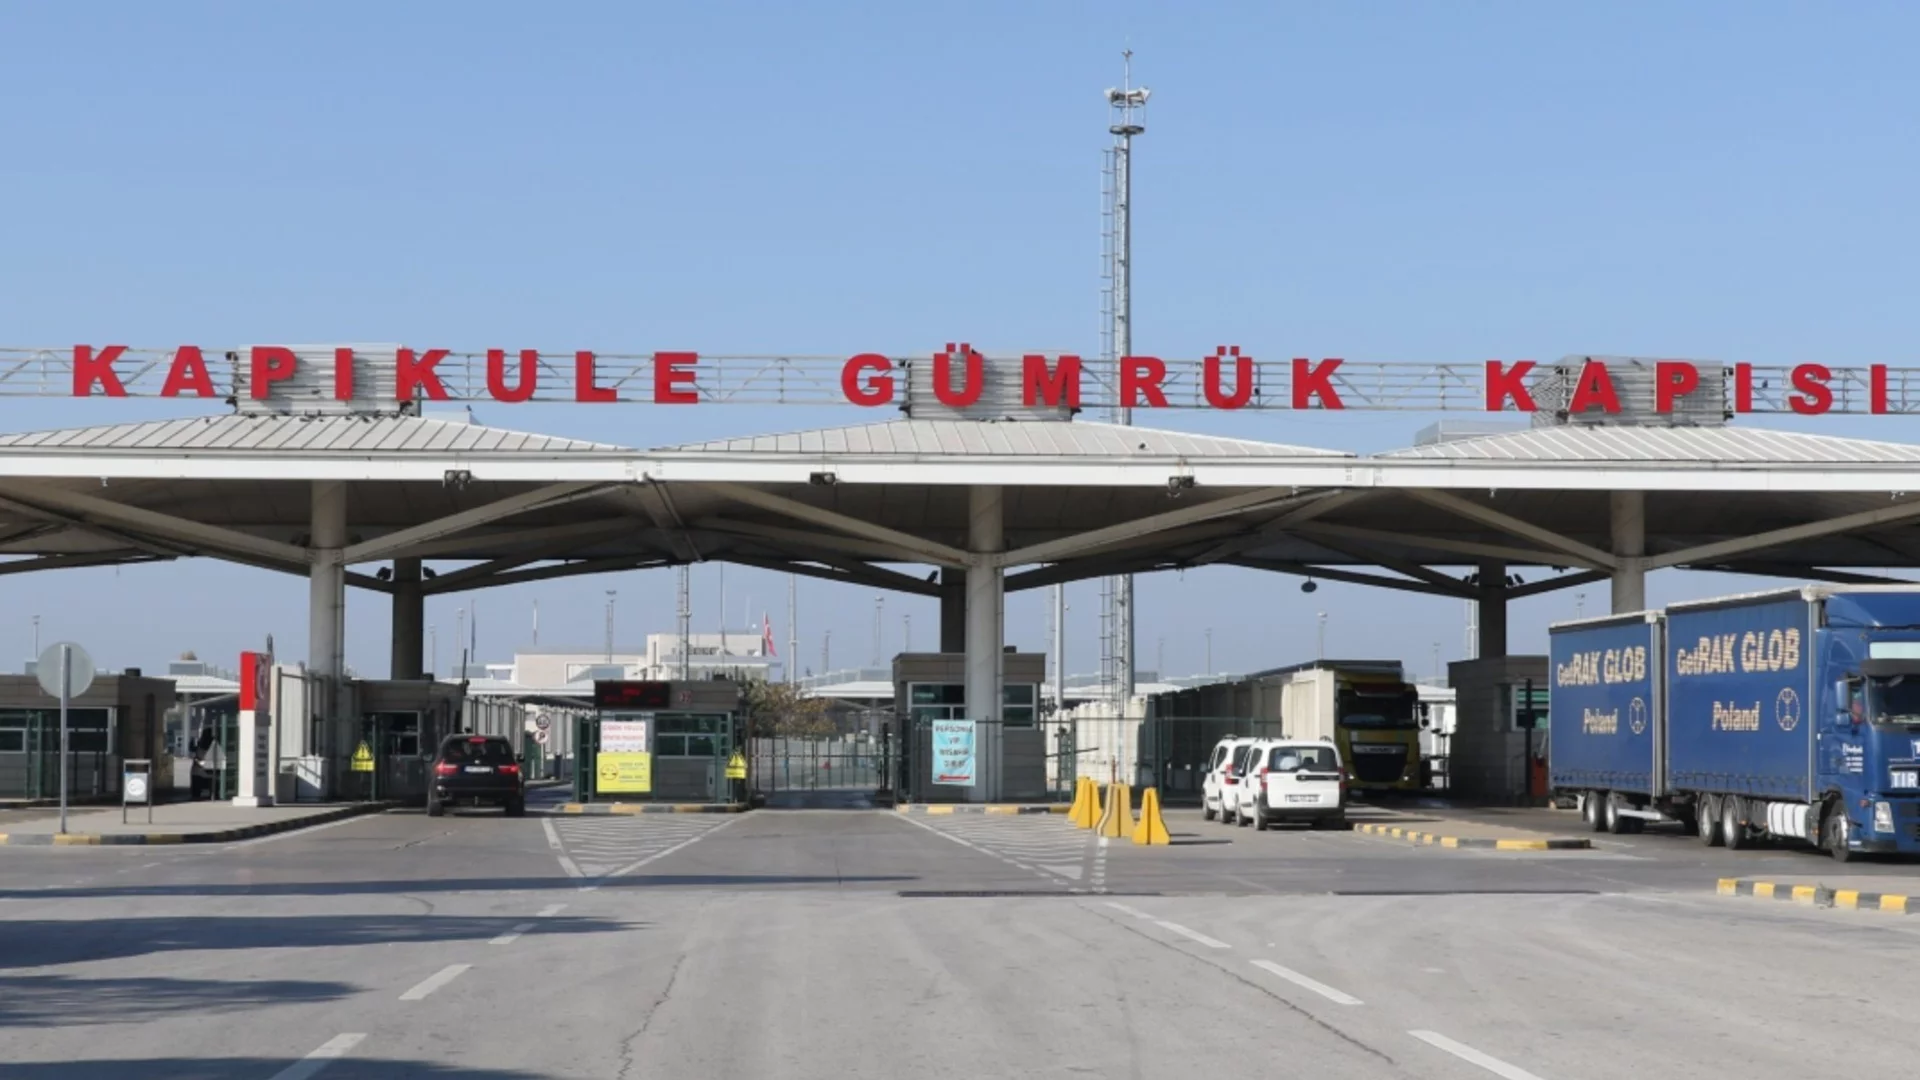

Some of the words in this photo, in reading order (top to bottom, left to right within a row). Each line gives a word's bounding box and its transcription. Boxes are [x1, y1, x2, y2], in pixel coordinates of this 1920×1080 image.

[73, 345, 699, 404] KAPIKULE
[841, 343, 1344, 410] GÜMRÜK
[1486, 360, 1888, 415] KAPISI
[1603, 646, 1647, 684] GLOB
[1741, 628, 1801, 673] GLOB
[1583, 707, 1619, 735] Poland
[1712, 701, 1761, 731] Poland
[1890, 771, 1919, 788] TIR
